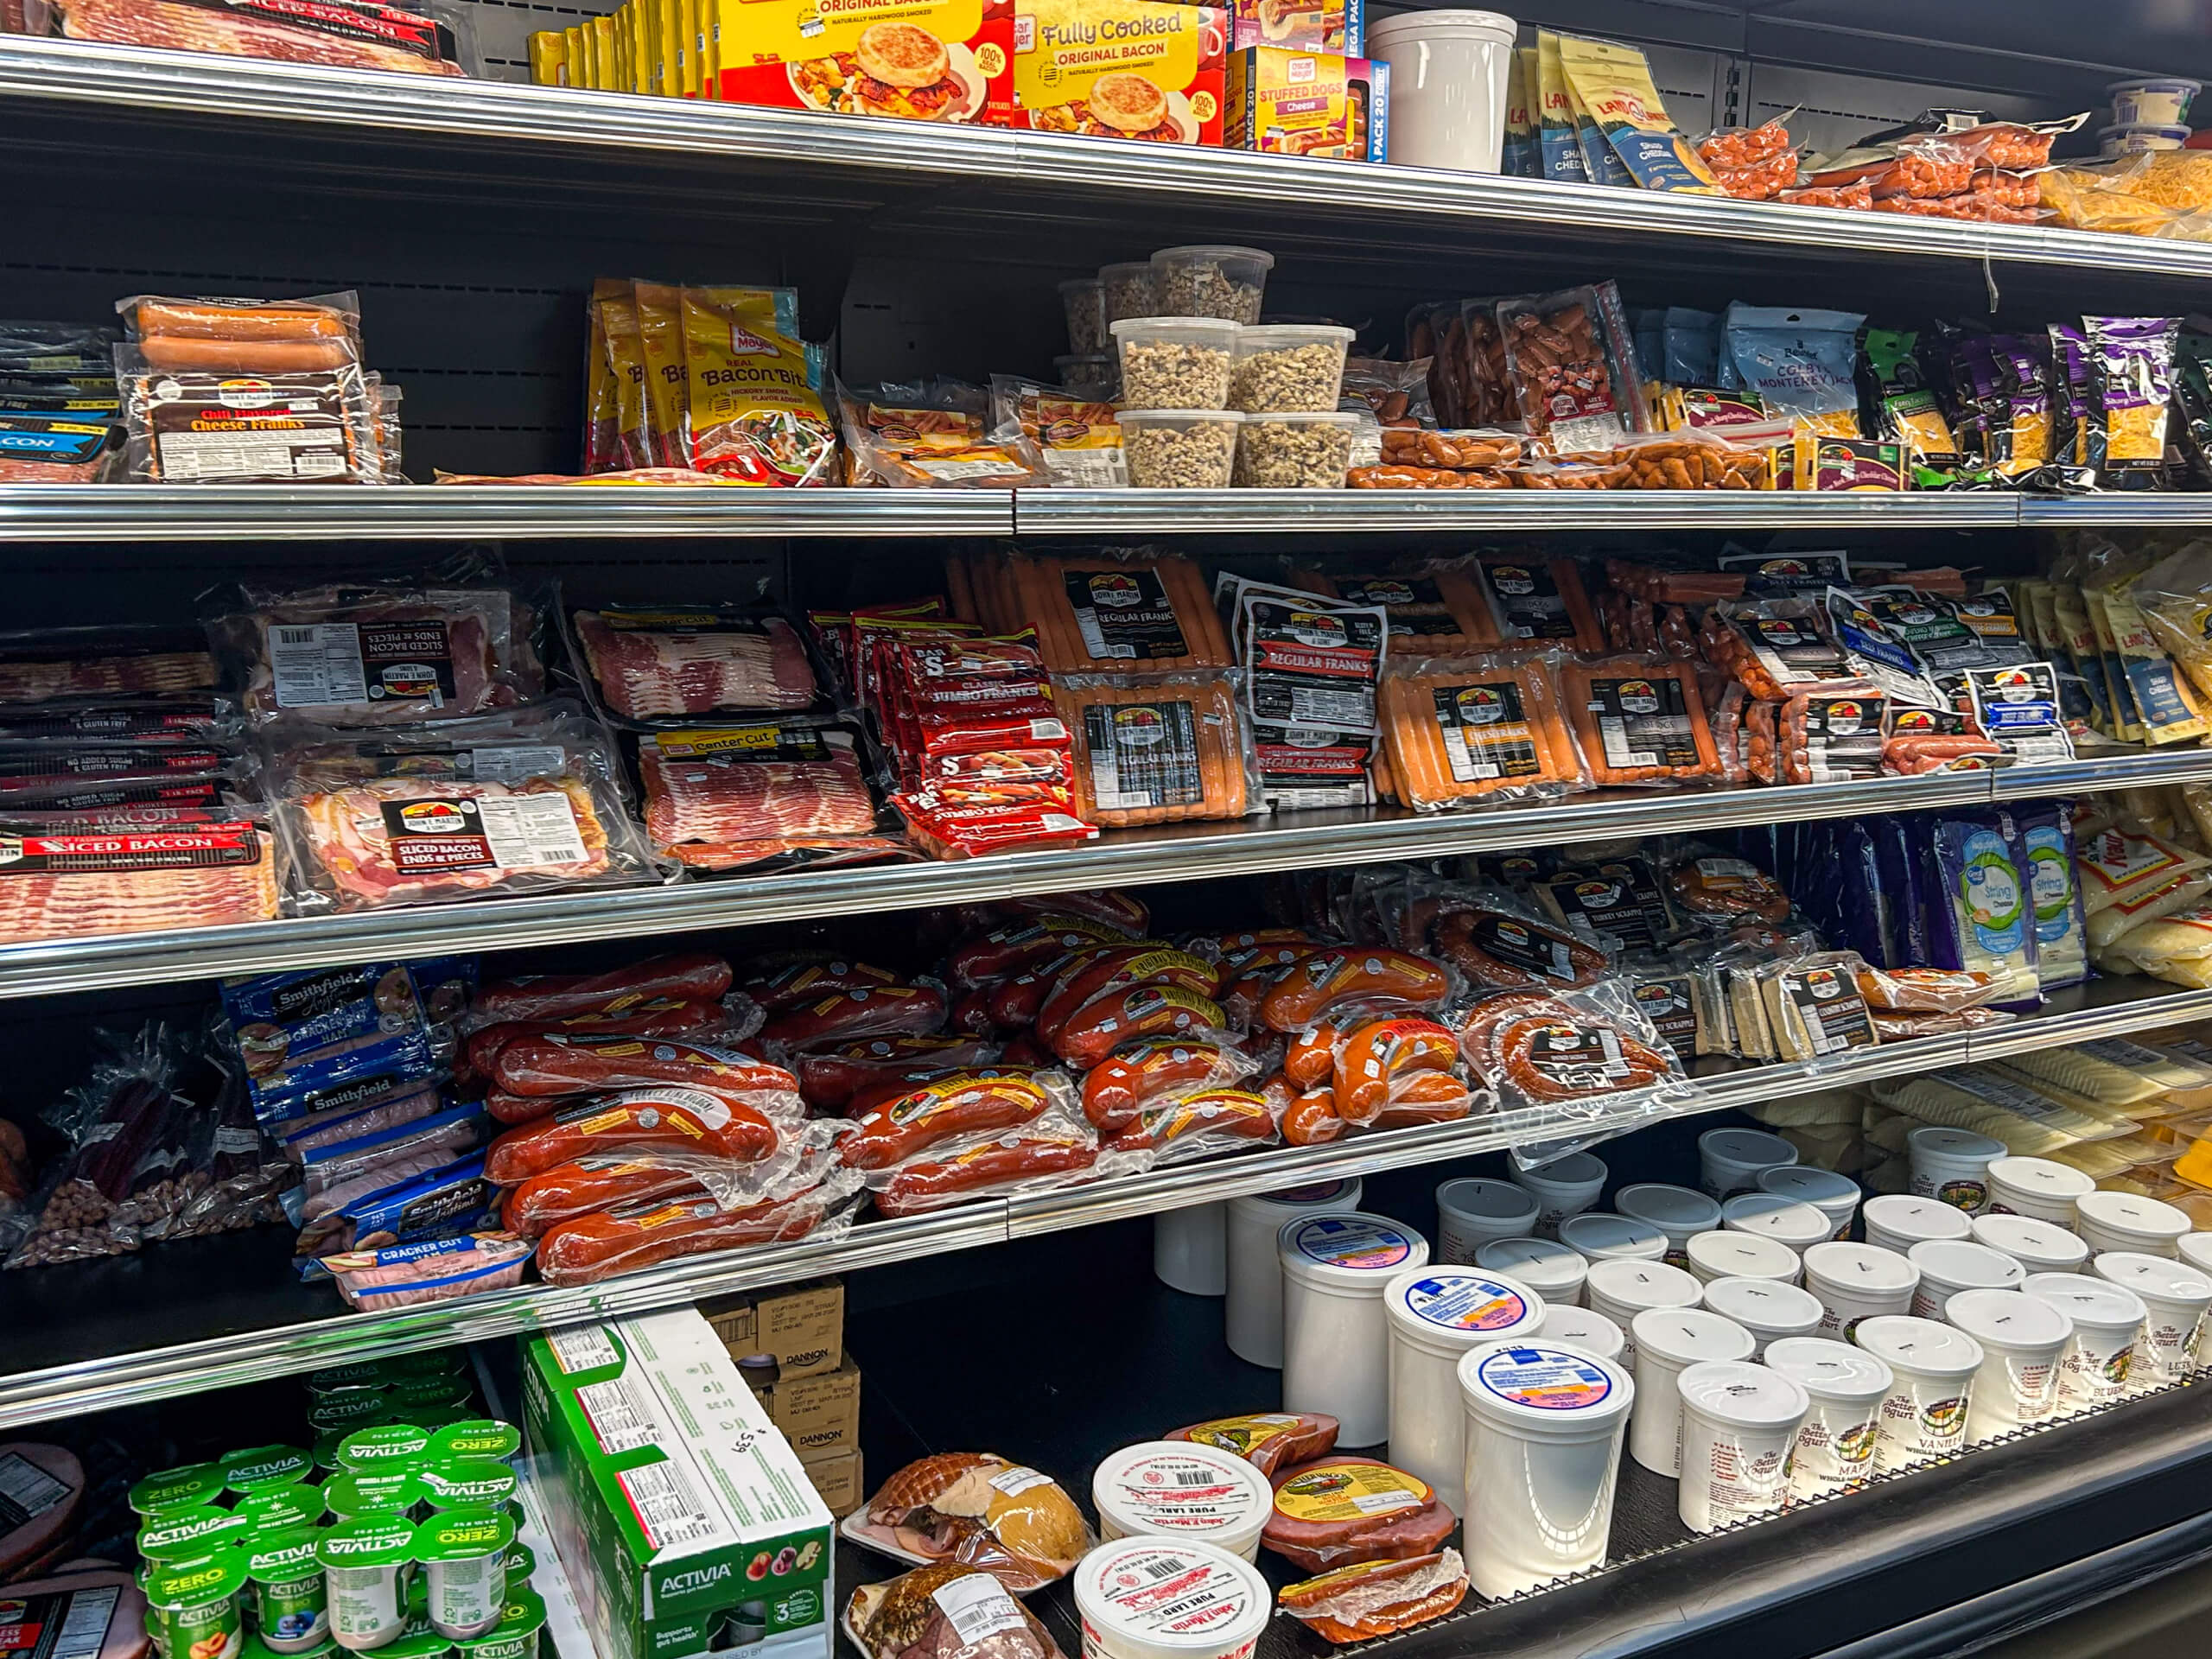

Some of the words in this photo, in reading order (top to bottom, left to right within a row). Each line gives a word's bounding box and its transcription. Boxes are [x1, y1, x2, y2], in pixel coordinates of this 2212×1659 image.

[819, 0, 890, 13] ORIGINAL
[315, 10, 397, 36] BACON
[832, 16, 868, 25] NATURALLY
[868, 10, 905, 22] HARDWOOD
[906, 8, 932, 18] SMOKED
[1042, 20, 1096, 47] Fully
[1100, 11, 1182, 40] Cooked
[979, 46, 1002, 63] 100%
[1058, 48, 1118, 66] ORIGINAL
[1121, 42, 1165, 57] BACON
[1260, 85, 1309, 103] STUFFED
[1312, 82, 1343, 96] DOGS
[1193, 94, 1213, 110] 100%
[1287, 100, 1316, 111] Cheese
[1374, 97, 1384, 117] 20
[1545, 92, 1570, 109] LAN
[1597, 102, 1628, 116] LAND
[1373, 118, 1384, 158] PACK
[1562, 149, 1581, 160] SHA
[726, 359, 753, 367] REAL
[700, 366, 774, 387] Bacon
[1758, 378, 1828, 388] MONTEREY
[200, 409, 232, 420] Chili
[233, 409, 291, 419] Flavored
[191, 419, 248, 432] Cheese
[251, 419, 305, 431] Franks
[1098, 612, 1141, 623] REGULAR
[1141, 611, 1176, 622] FRANKS
[367, 632, 403, 643] PIECES
[414, 631, 442, 641] ENDS
[369, 642, 410, 653] BACON
[415, 641, 443, 652] SLICED
[915, 648, 946, 658] BAR
[925, 656, 945, 677] S
[1269, 652, 1323, 669] REGULAR
[1324, 656, 1370, 673] FRANKS
[961, 680, 1006, 690] CLASSIC
[932, 690, 982, 702] JUMBO
[695, 737, 745, 752] Center
[747, 732, 772, 746] Cut
[80, 757, 107, 766] ADDED
[108, 756, 133, 766] SUGAR
[940, 755, 960, 776] S
[1258, 758, 1310, 769] REGULAR
[71, 794, 97, 804] ADDED
[99, 791, 126, 800] SUGAR
[131, 801, 168, 810] SMOKED
[96, 810, 181, 825] BACON
[934, 809, 985, 822] JUMBO
[129, 837, 213, 851] BACON
[398, 845, 436, 856] SLICED
[439, 842, 481, 854] BACON
[402, 854, 432, 864] ENDS
[435, 854, 446, 862] &
[448, 851, 485, 861] PIECES
[1984, 881, 2012, 899] String
[2035, 876, 2064, 891] String
[1637, 890, 1660, 900] CRAPPLE
[1592, 912, 1618, 923] TURKEY
[1135, 952, 1166, 973] ORIGINAL
[279, 972, 355, 1005] Smithfield
[293, 1016, 346, 1043] CRACKER
[1664, 1019, 1695, 1031] SCRAPPLE
[314, 1080, 391, 1111] Smithfield
[664, 1089, 684, 1099] RING
[381, 1243, 438, 1261] CRACKER
[437, 1237, 463, 1249] CUT
[1823, 1306, 1836, 1316] The
[1821, 1314, 1842, 1324] etter
[1818, 1321, 1840, 1332] gurt
[2152, 1330, 2182, 1340] Better
[786, 1349, 829, 1365] DANNON
[312, 1365, 380, 1382] ACTIVIA
[1882, 1399, 1916, 1412] Better
[1897, 1395, 1910, 1404] The
[313, 1398, 384, 1419] ACTIVIA
[1884, 1407, 1915, 1421] ogurt
[1810, 1422, 1826, 1433] The
[799, 1429, 843, 1446] DANNON
[1797, 1434, 1829, 1448] ogurt
[349, 1438, 429, 1458] ACTIVIA
[450, 1439, 507, 1451] ZERO
[1763, 1451, 1777, 1459] The
[228, 1456, 302, 1478] ACTIVIA
[1819, 1474, 1847, 1483] WHOLE
[148, 1480, 203, 1501] ZERO
[434, 1478, 514, 1497] ACTIVIA
[1188, 1505, 1217, 1514] PURE
[1153, 1517, 1192, 1527] Martin
[142, 1517, 221, 1545] ACTIVIA
[437, 1529, 499, 1543] ZERO
[325, 1531, 414, 1554] ACTIVIA
[163, 1568, 224, 1592] ZERO
[660, 1563, 732, 1593] ACTIVIA
[269, 1577, 321, 1595] ACTIVIA
[660, 1589, 685, 1599] Supports
[1189, 1592, 1217, 1607] PURE
[178, 1599, 231, 1623] ACTIVIA
[776, 1602, 790, 1622] 3
[1161, 1602, 1190, 1616] LARD
[1210, 1603, 1237, 1616] John
[1170, 1614, 1209, 1631] Martin
[656, 1625, 693, 1640] Supports
[473, 1640, 525, 1656] ACTIVIA
[656, 1637, 671, 1649] gut
